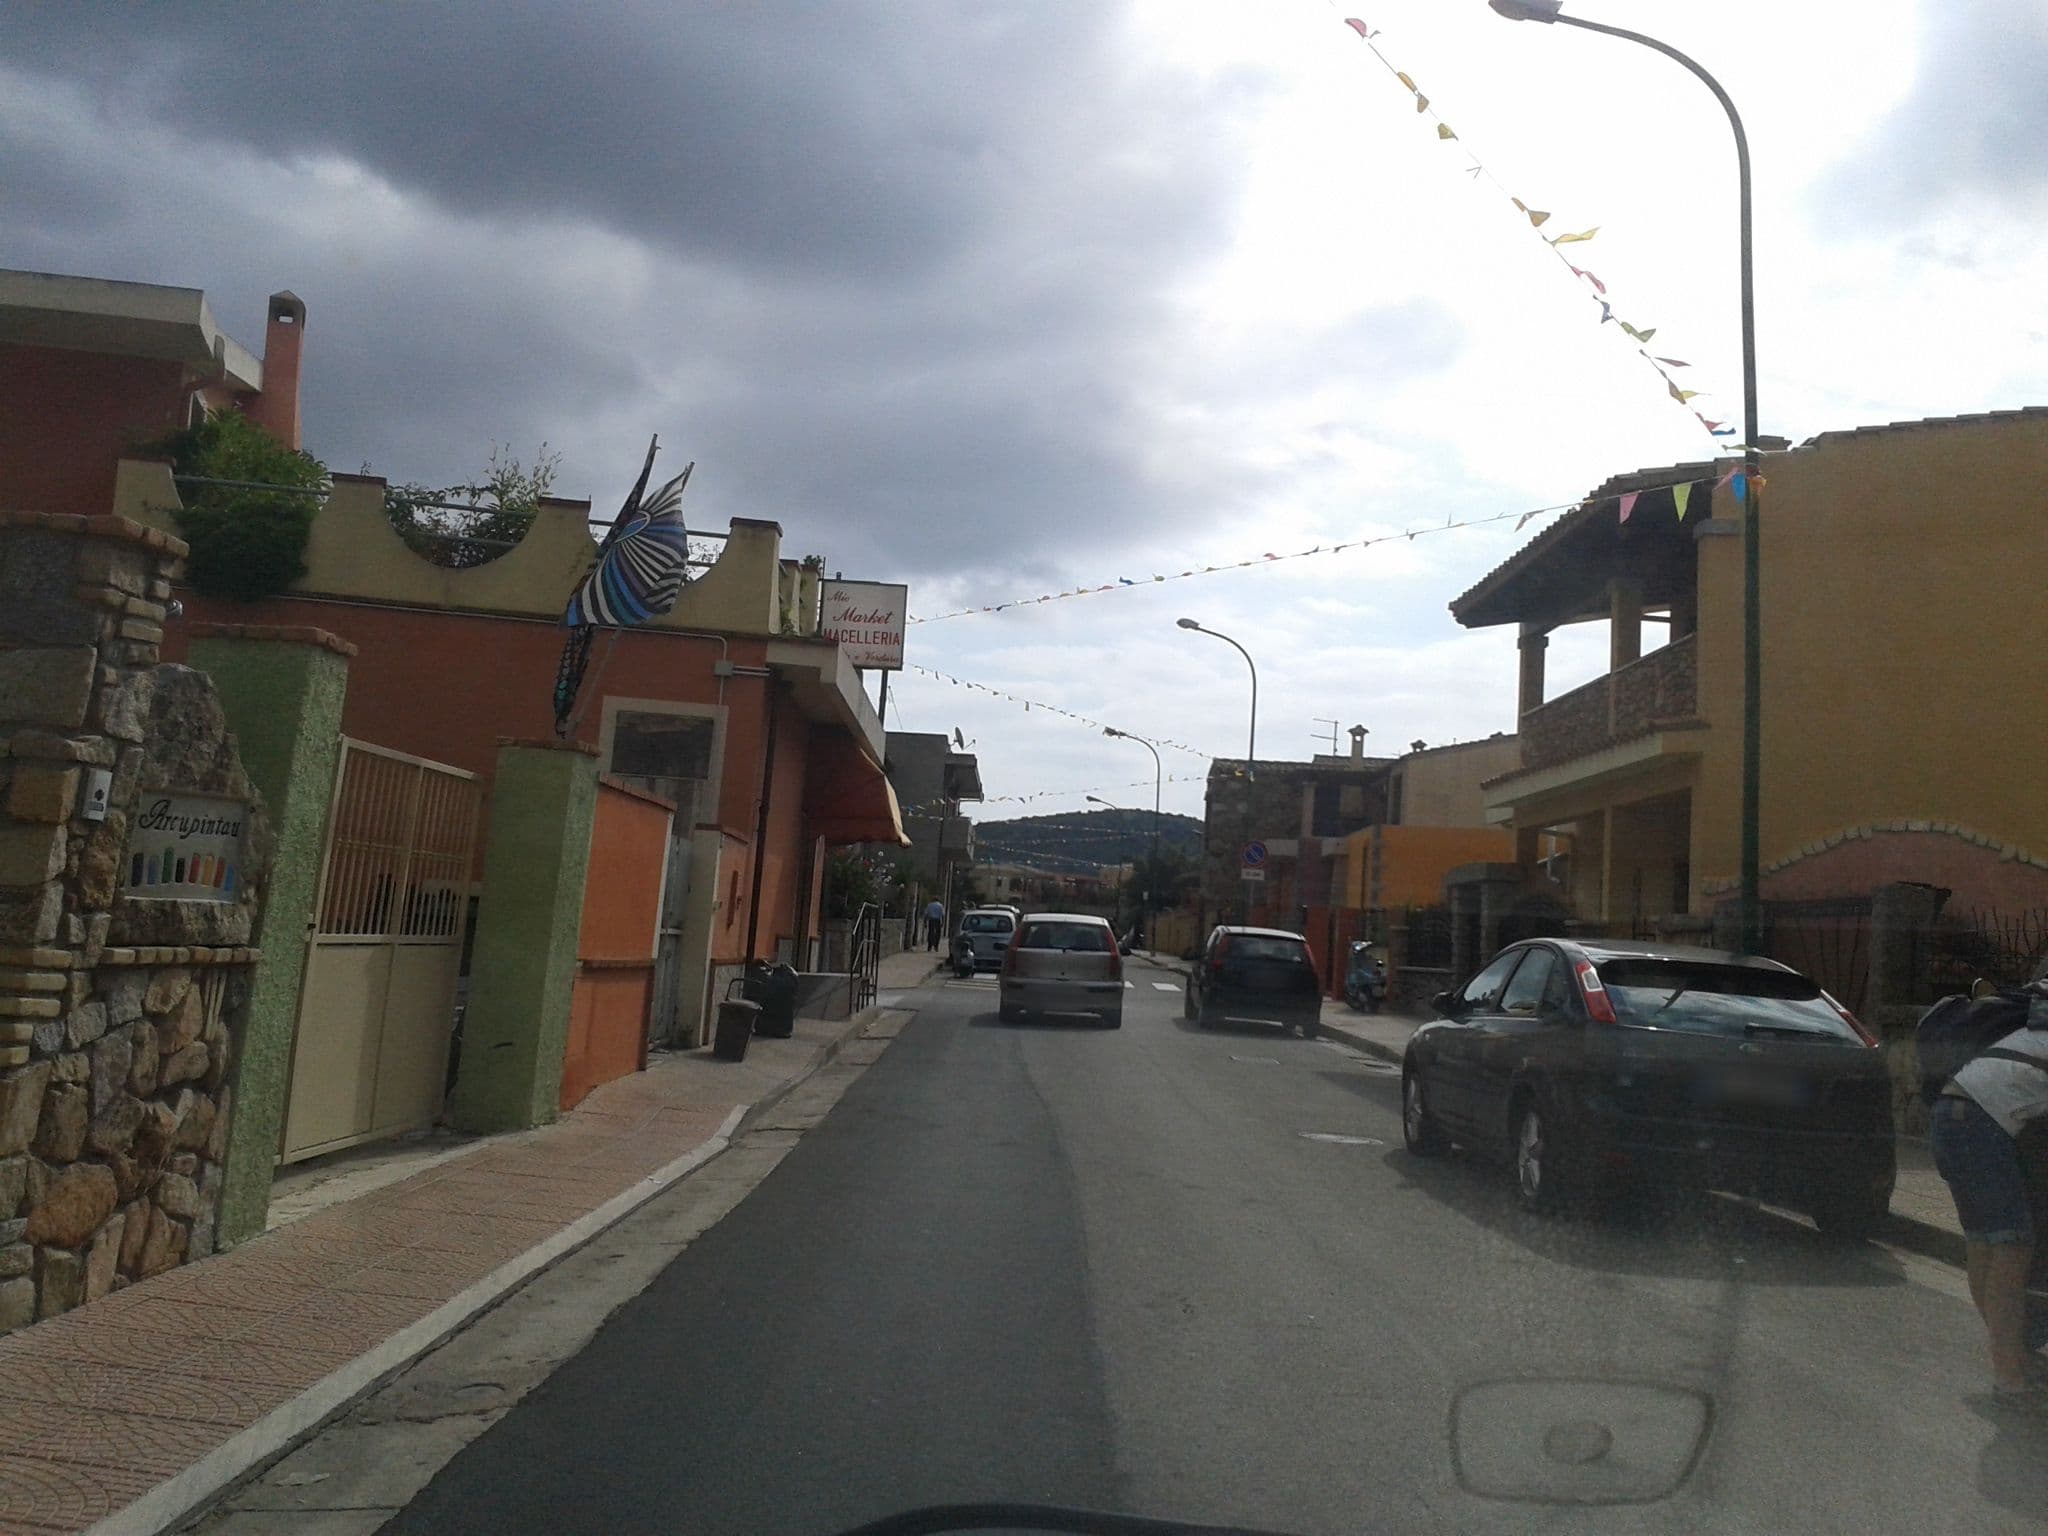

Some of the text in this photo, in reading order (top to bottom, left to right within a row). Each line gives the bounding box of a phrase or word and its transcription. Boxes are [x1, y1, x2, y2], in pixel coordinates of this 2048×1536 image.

[832, 607, 895, 624] Market
[823, 628, 900, 646] MACELLERIA
[138, 799, 240, 839] Arcupintau
